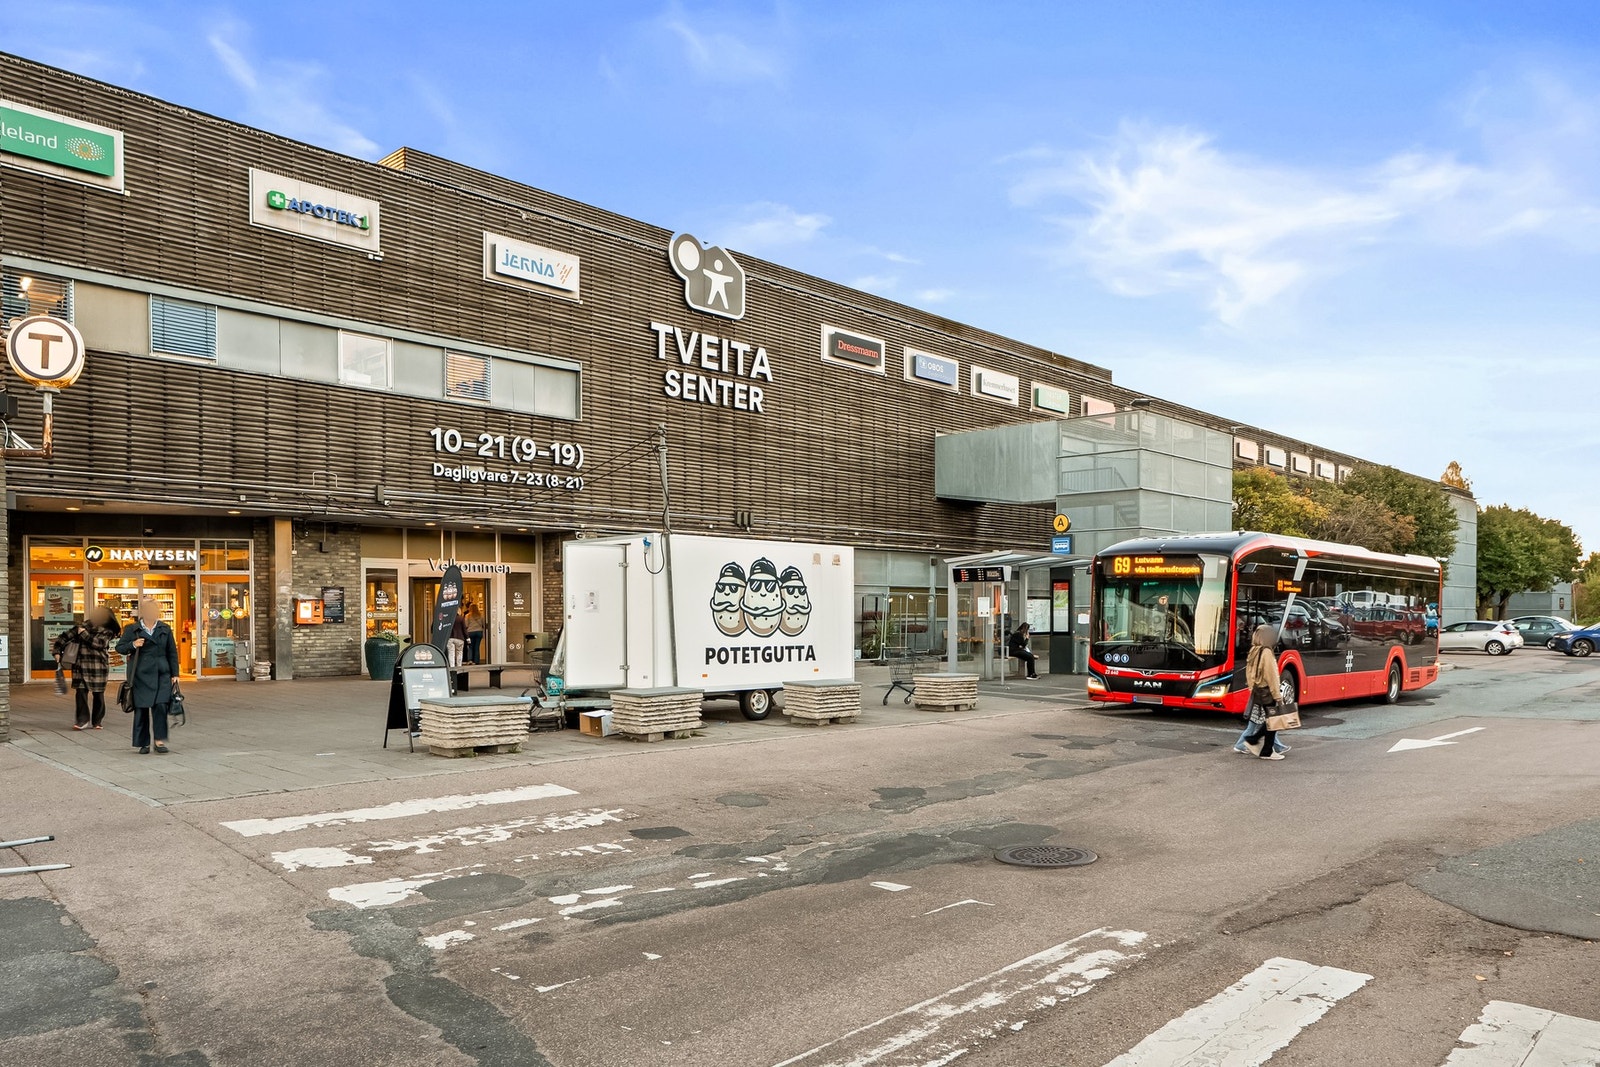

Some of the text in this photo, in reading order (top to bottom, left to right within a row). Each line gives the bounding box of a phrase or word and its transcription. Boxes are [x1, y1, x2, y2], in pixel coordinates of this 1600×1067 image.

[287, 197, 359, 227] APOTEK
[28, 332, 63, 369] T
[650, 322, 774, 382] TVEITA
[837, 339, 879, 359] Dressmann
[927, 362, 944, 374] OBOS
[664, 370, 764, 413] SENTER
[433, 462, 585, 493] Dagligvare 7-23 (8-21)
[1057, 518, 1065, 527] A
[110, 549, 197, 561] NARVESEN
[1114, 557, 1130, 573] 69
[705, 644, 816, 665] POTETGUTTA
[1133, 680, 1162, 688] MAN
